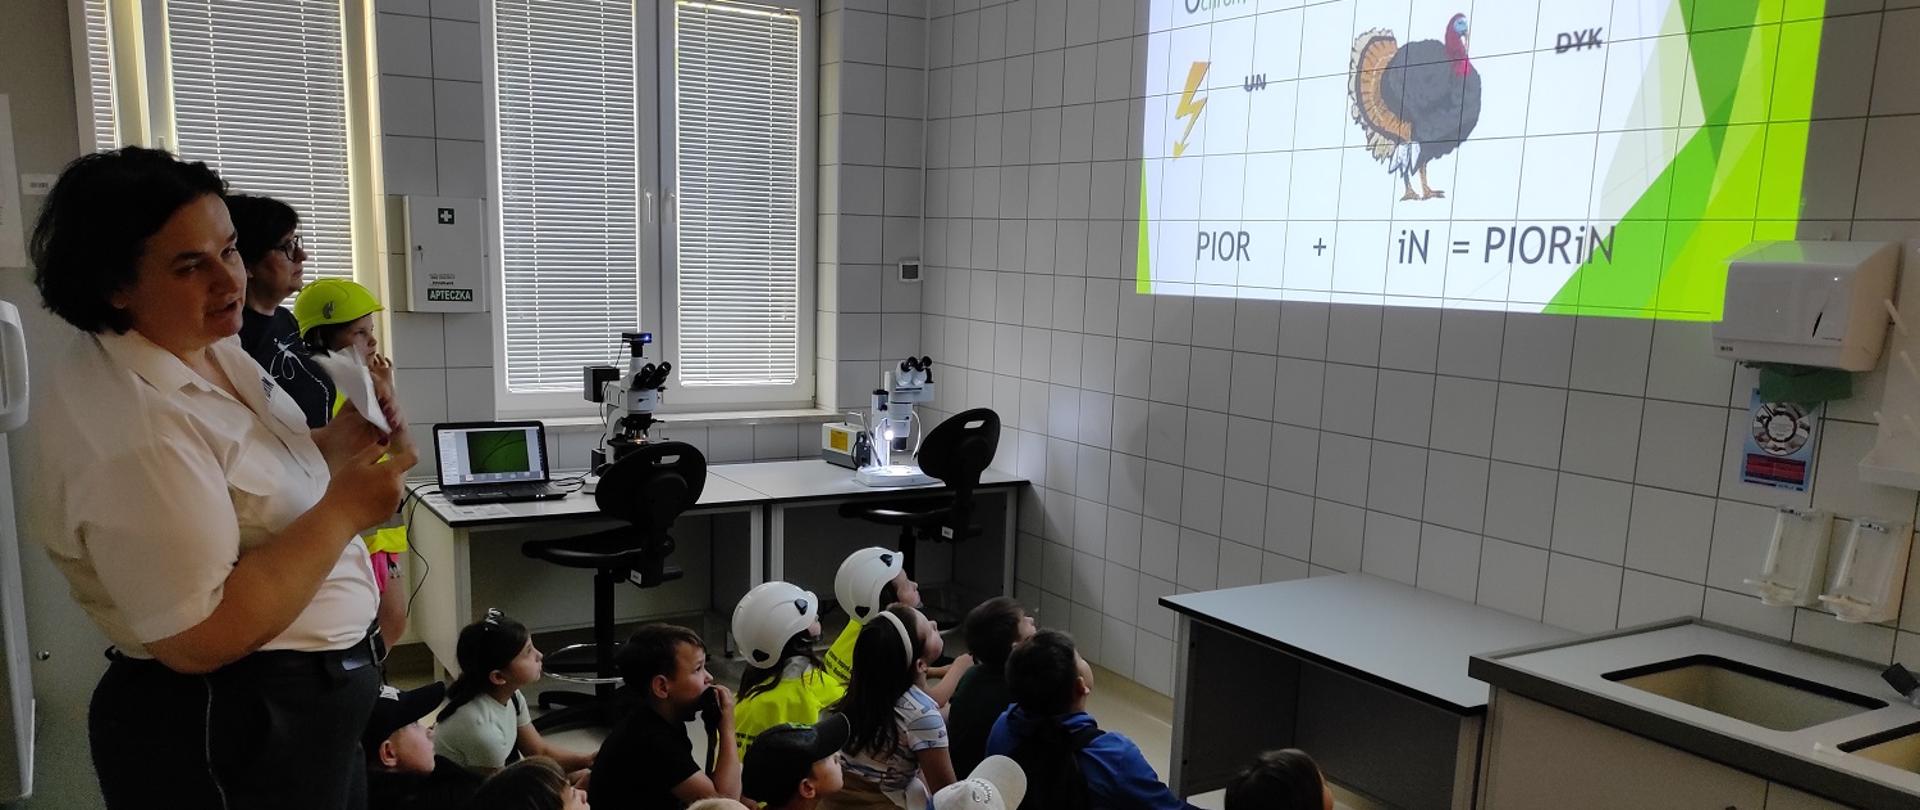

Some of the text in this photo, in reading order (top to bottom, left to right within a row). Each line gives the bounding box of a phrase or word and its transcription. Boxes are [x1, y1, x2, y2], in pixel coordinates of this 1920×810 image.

[1555, 26, 1602, 54] DYK
[1244, 73, 1267, 92] UN
[1196, 230, 1251, 261] PIOR
[1398, 229, 1430, 264] iN
[1484, 225, 1616, 264] PIORiN
[429, 290, 471, 301] APTECZKA
